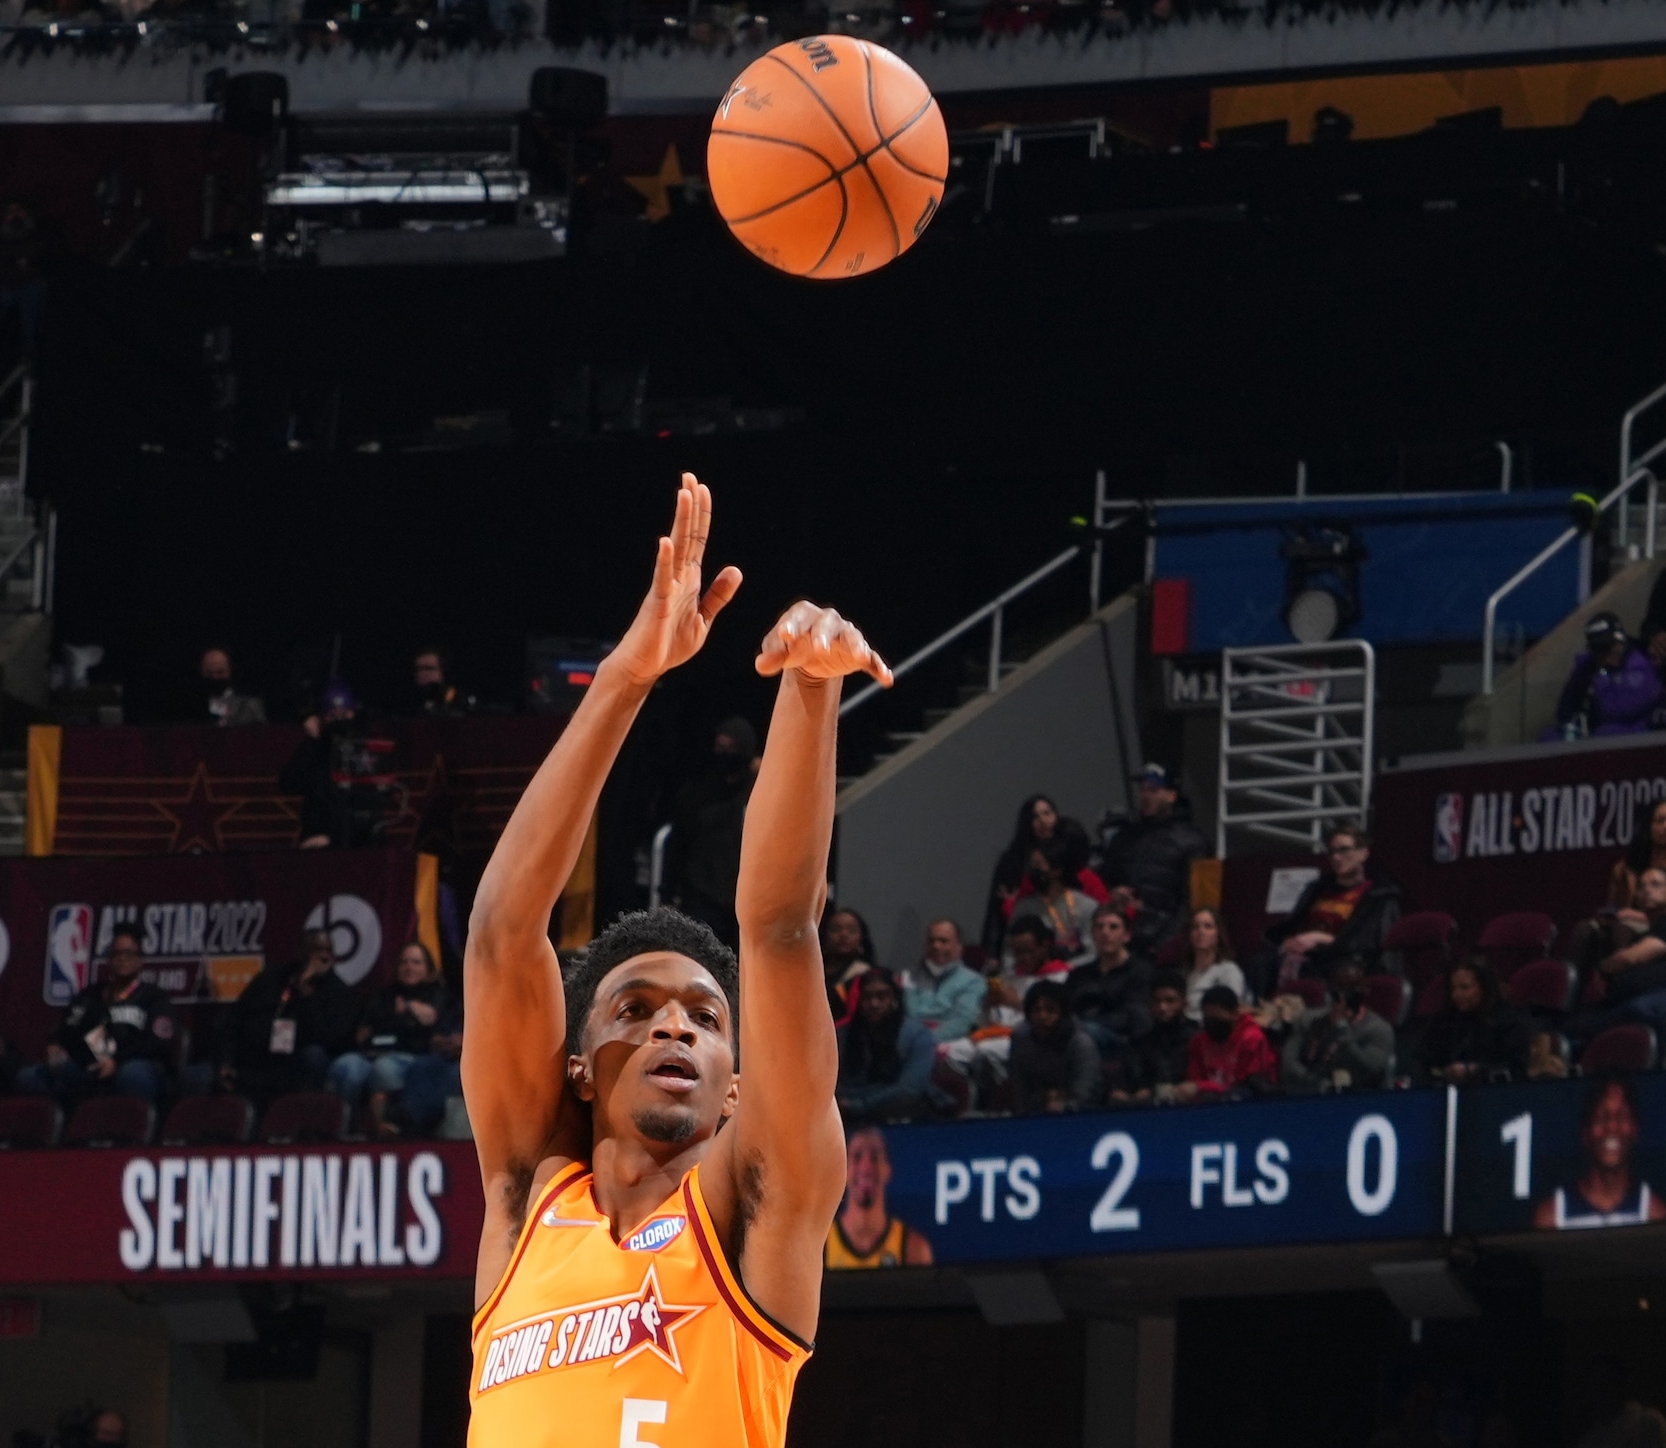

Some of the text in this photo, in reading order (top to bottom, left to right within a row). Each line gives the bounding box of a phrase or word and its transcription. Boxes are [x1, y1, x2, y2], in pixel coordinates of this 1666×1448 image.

[1466, 792, 1516, 857] ALL
[1521, 783, 1599, 852] STAR
[142, 902, 207, 955] STAR
[935, 1114, 1398, 1232] PTS 2 FLS 0
[1501, 1112, 1532, 1199] 1
[118, 1150, 444, 1271] SEMIFINALS
[629, 1216, 683, 1250] CLOROX
[478, 1300, 640, 1392] RISING STARS
